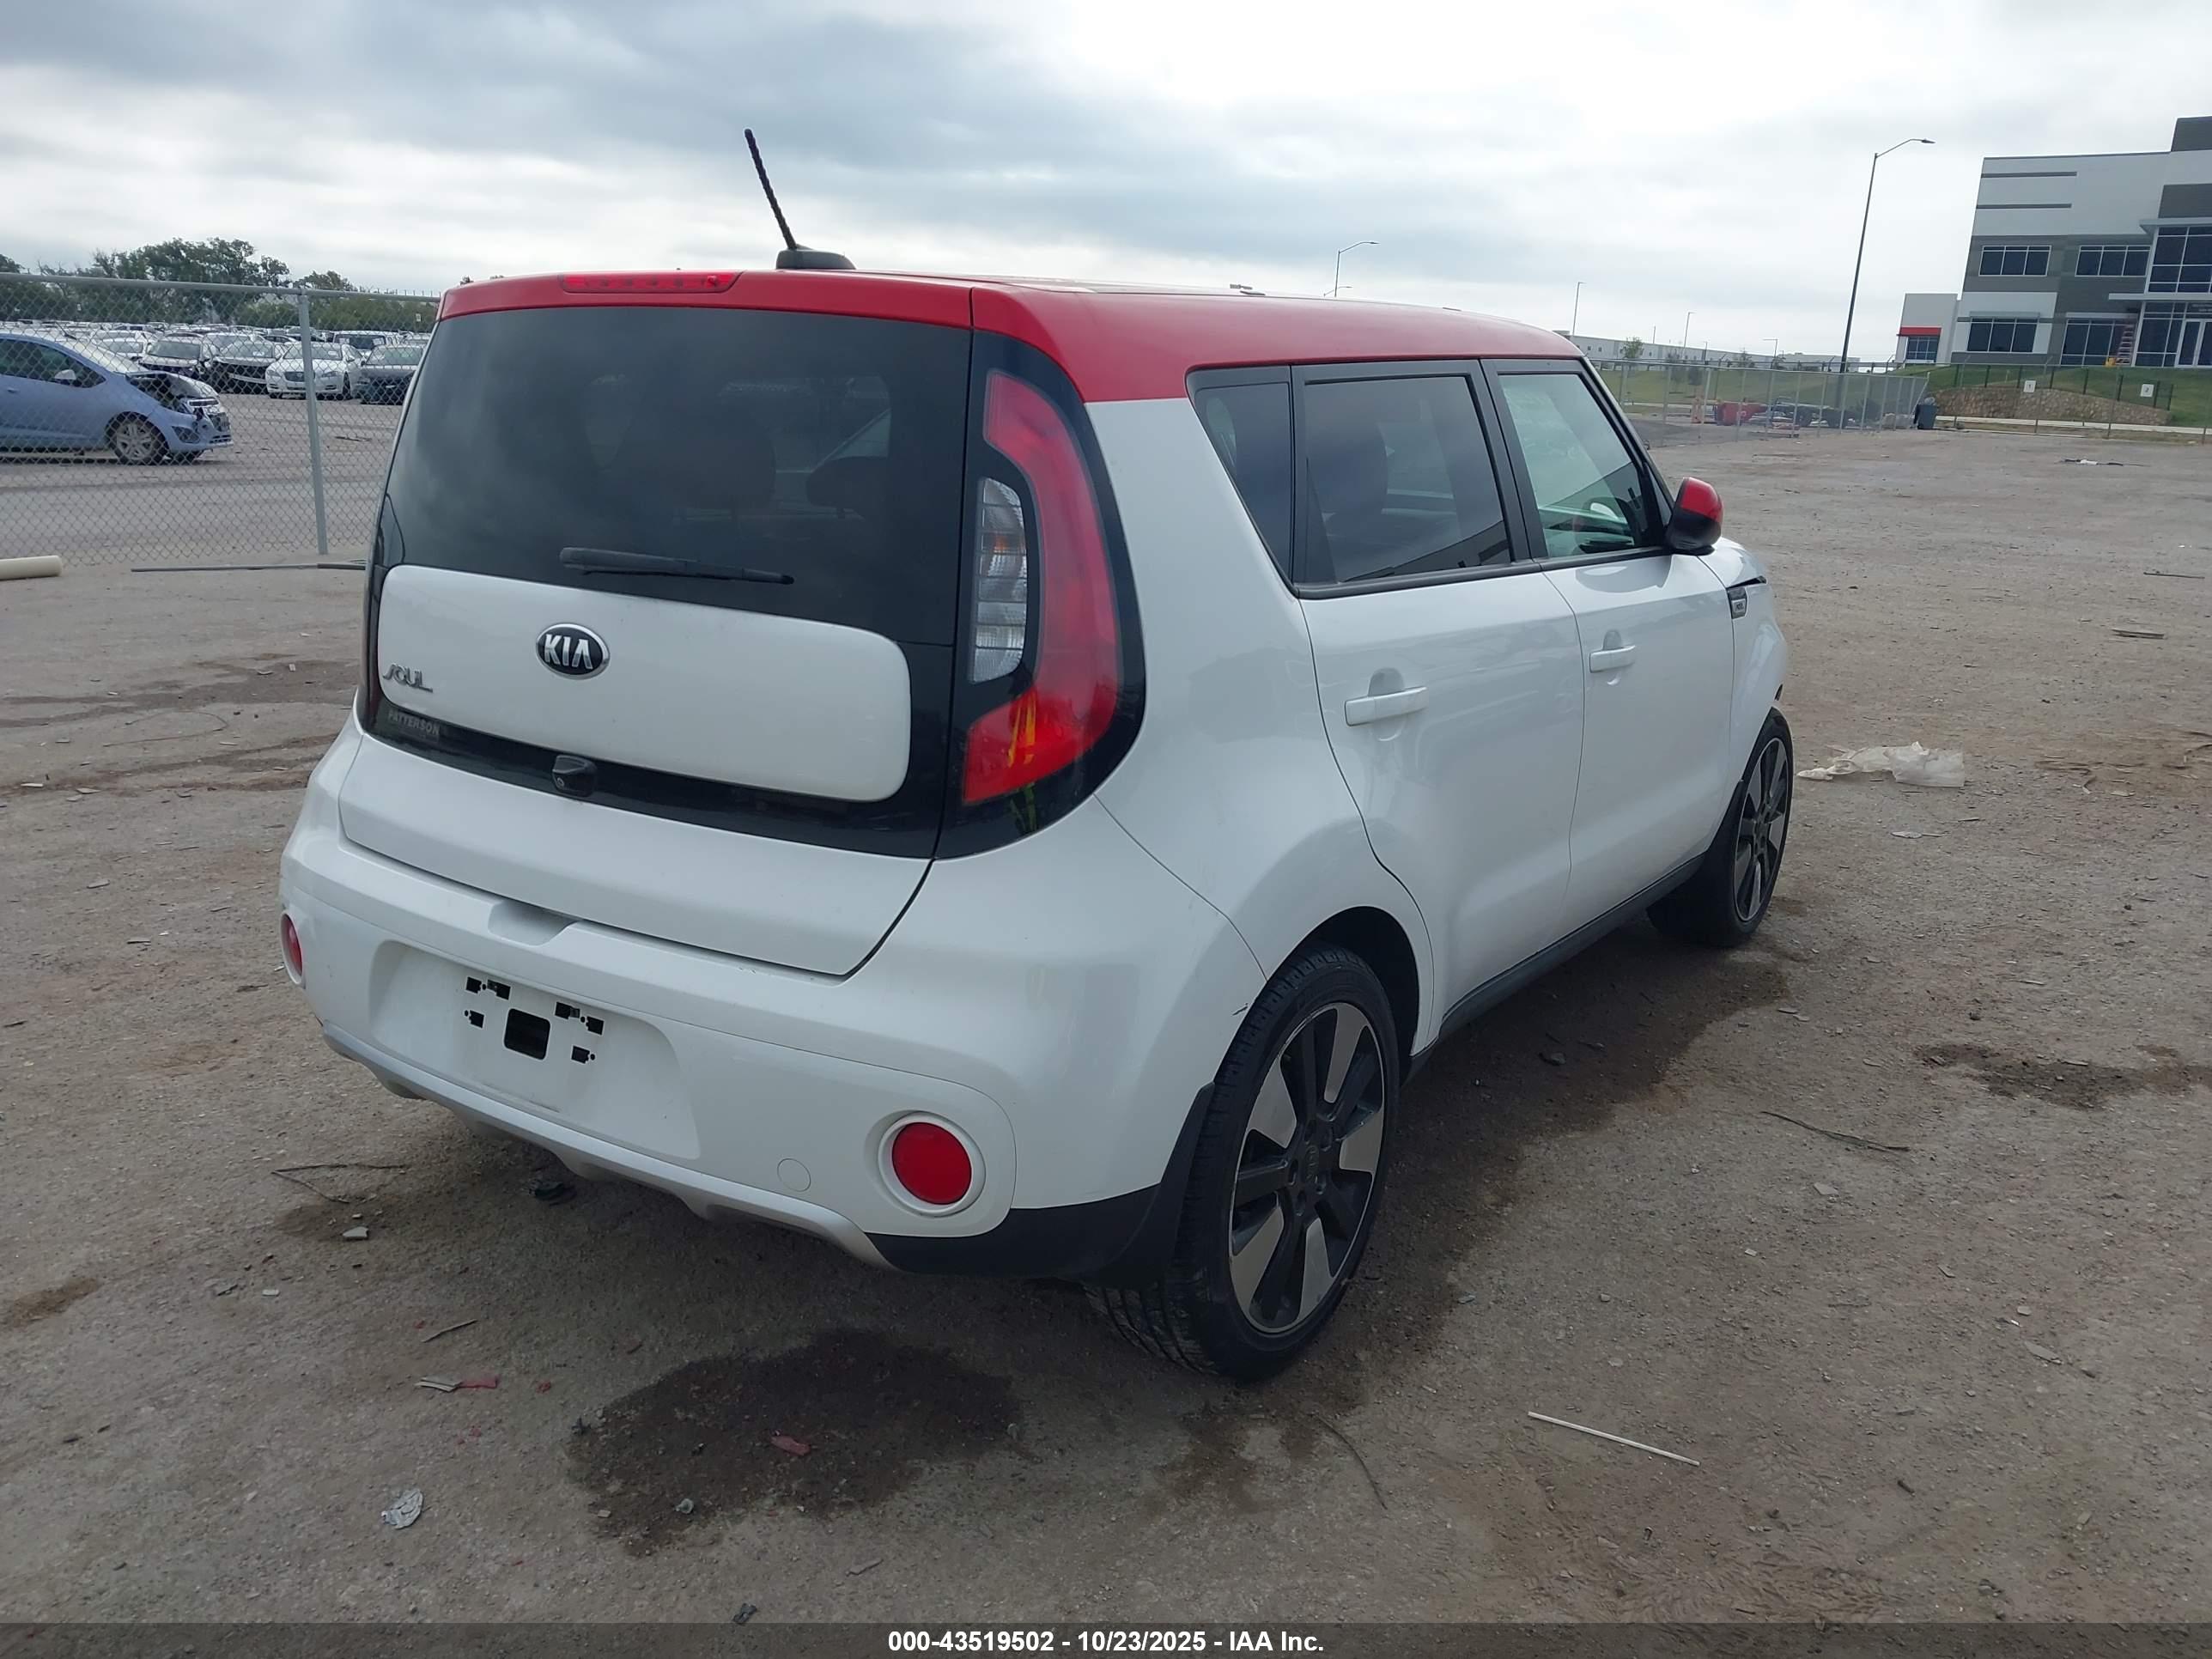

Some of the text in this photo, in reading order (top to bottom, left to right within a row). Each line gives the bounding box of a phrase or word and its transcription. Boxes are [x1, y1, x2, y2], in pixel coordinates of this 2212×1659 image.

[544, 634, 593, 670] KIA
[382, 662, 433, 693] SOUL
[388, 710, 440, 736] PATTERSON
